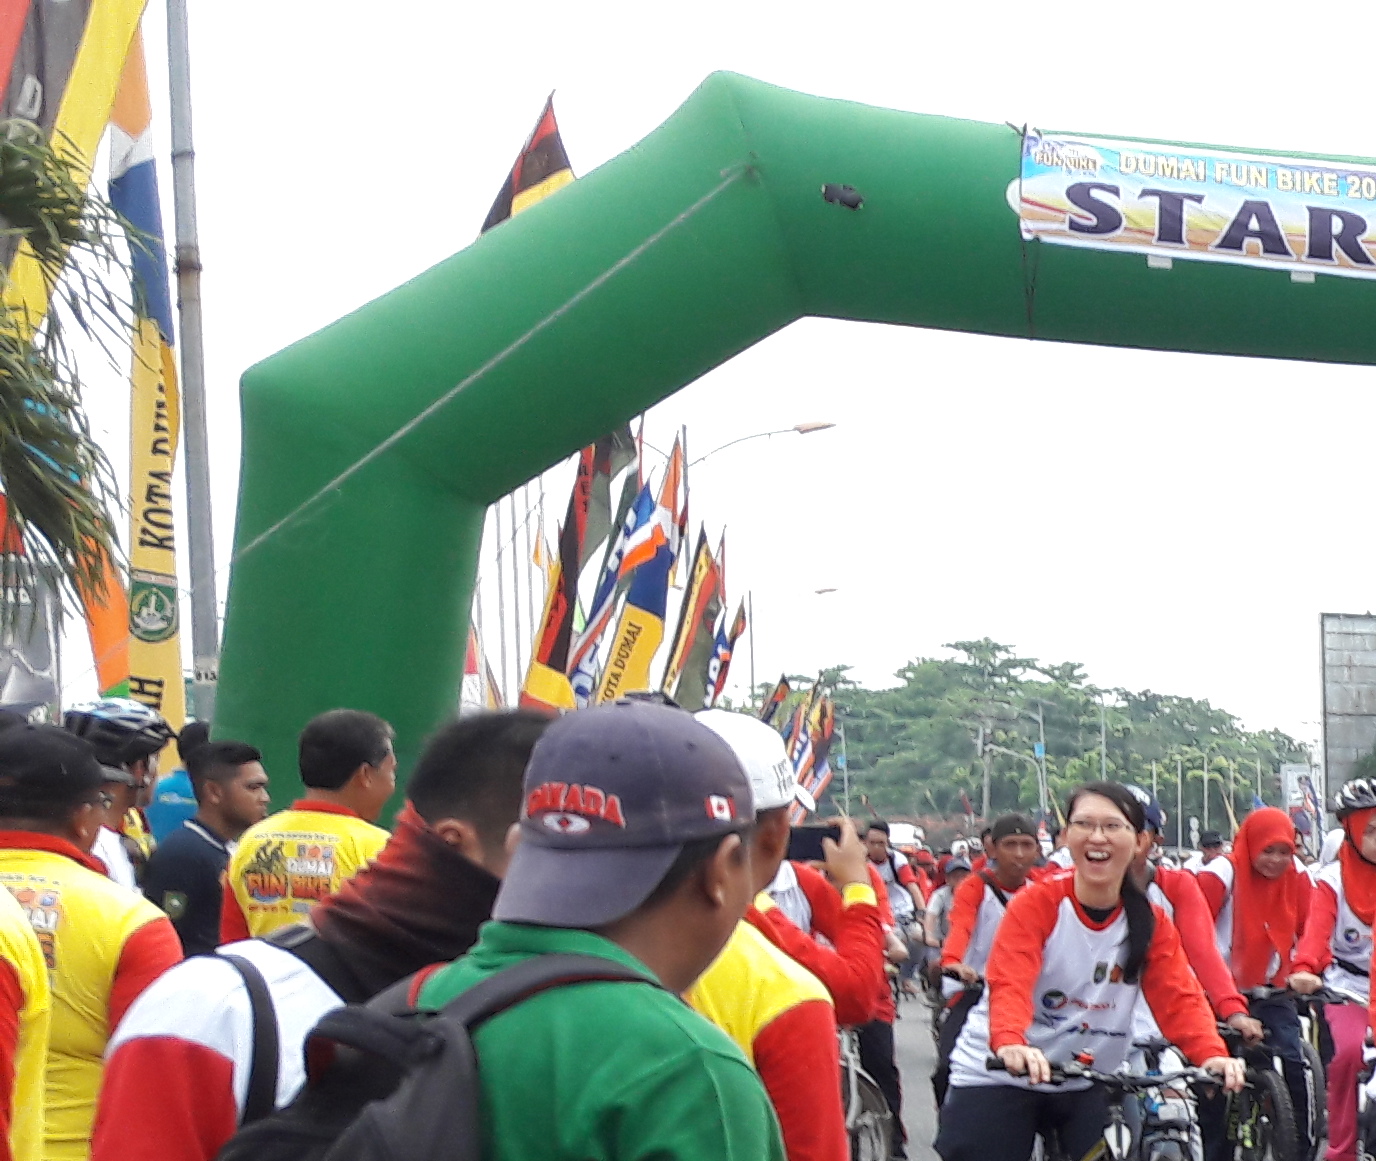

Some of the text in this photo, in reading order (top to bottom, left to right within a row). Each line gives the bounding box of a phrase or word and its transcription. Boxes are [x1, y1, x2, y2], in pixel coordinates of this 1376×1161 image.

[1119, 150, 1207, 183] DUMAI
[1213, 161, 1269, 190] FUN
[1276, 168, 1341, 197] BIKE
[614, 620, 644, 671] DUMAI
[247, 872, 288, 899] FUN
